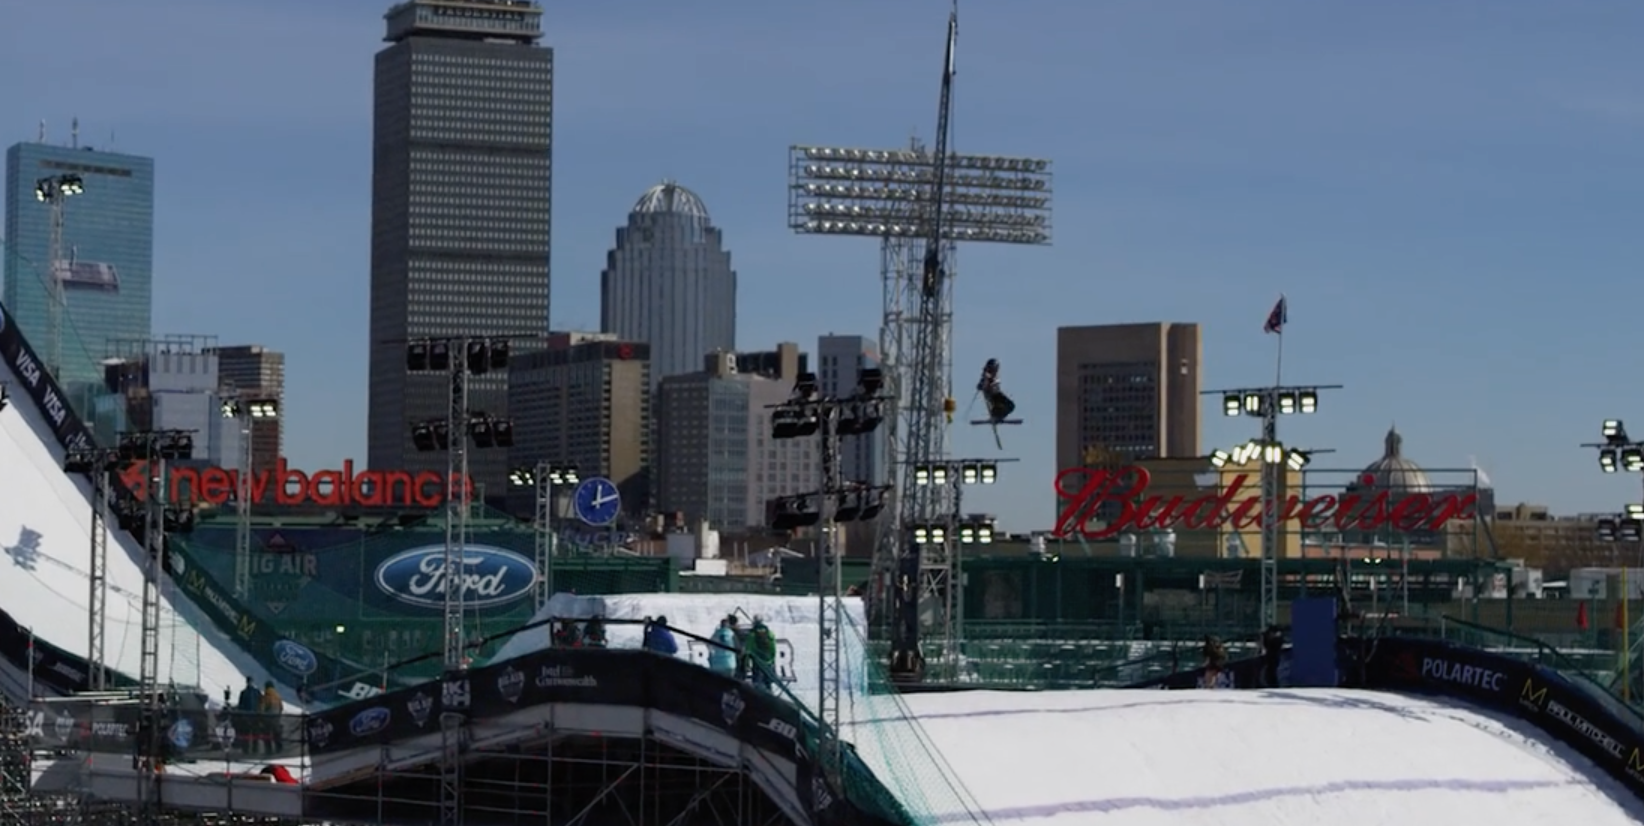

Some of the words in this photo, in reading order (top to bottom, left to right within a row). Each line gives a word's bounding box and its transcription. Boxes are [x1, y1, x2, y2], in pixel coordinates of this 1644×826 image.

[16, 347, 41, 388] VISA
[43, 383, 66, 426] VISA
[1053, 465, 1478, 539] Budweiser
[246, 553, 274, 575] IG
[279, 553, 317, 576] AIR
[408, 553, 508, 596] Ford
[280, 645, 310, 671] Ford
[1422, 657, 1503, 691] POLARTEC
